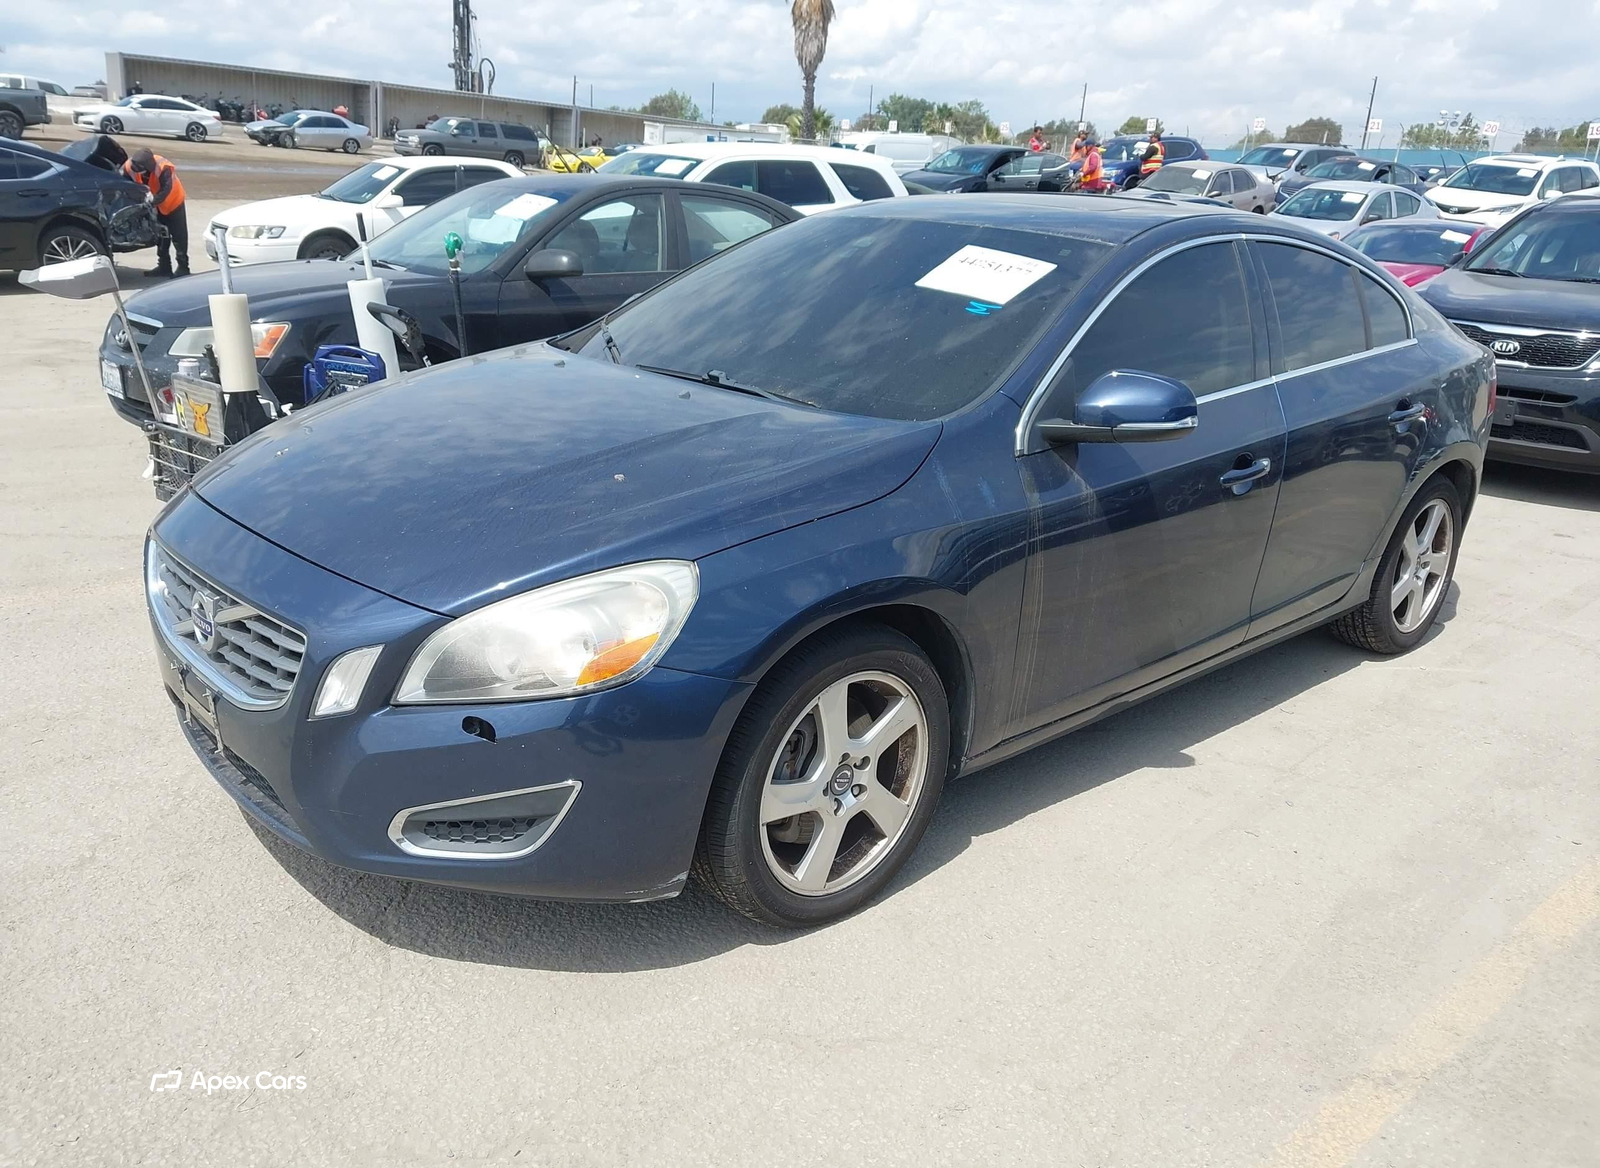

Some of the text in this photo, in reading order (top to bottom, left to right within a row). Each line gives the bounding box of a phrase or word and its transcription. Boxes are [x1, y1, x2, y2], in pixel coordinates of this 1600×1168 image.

[1254, 120, 1265, 128] 22
[1369, 121, 1380, 130] 21
[1484, 123, 1498, 133] 20
[1494, 341, 1515, 352] KIA
